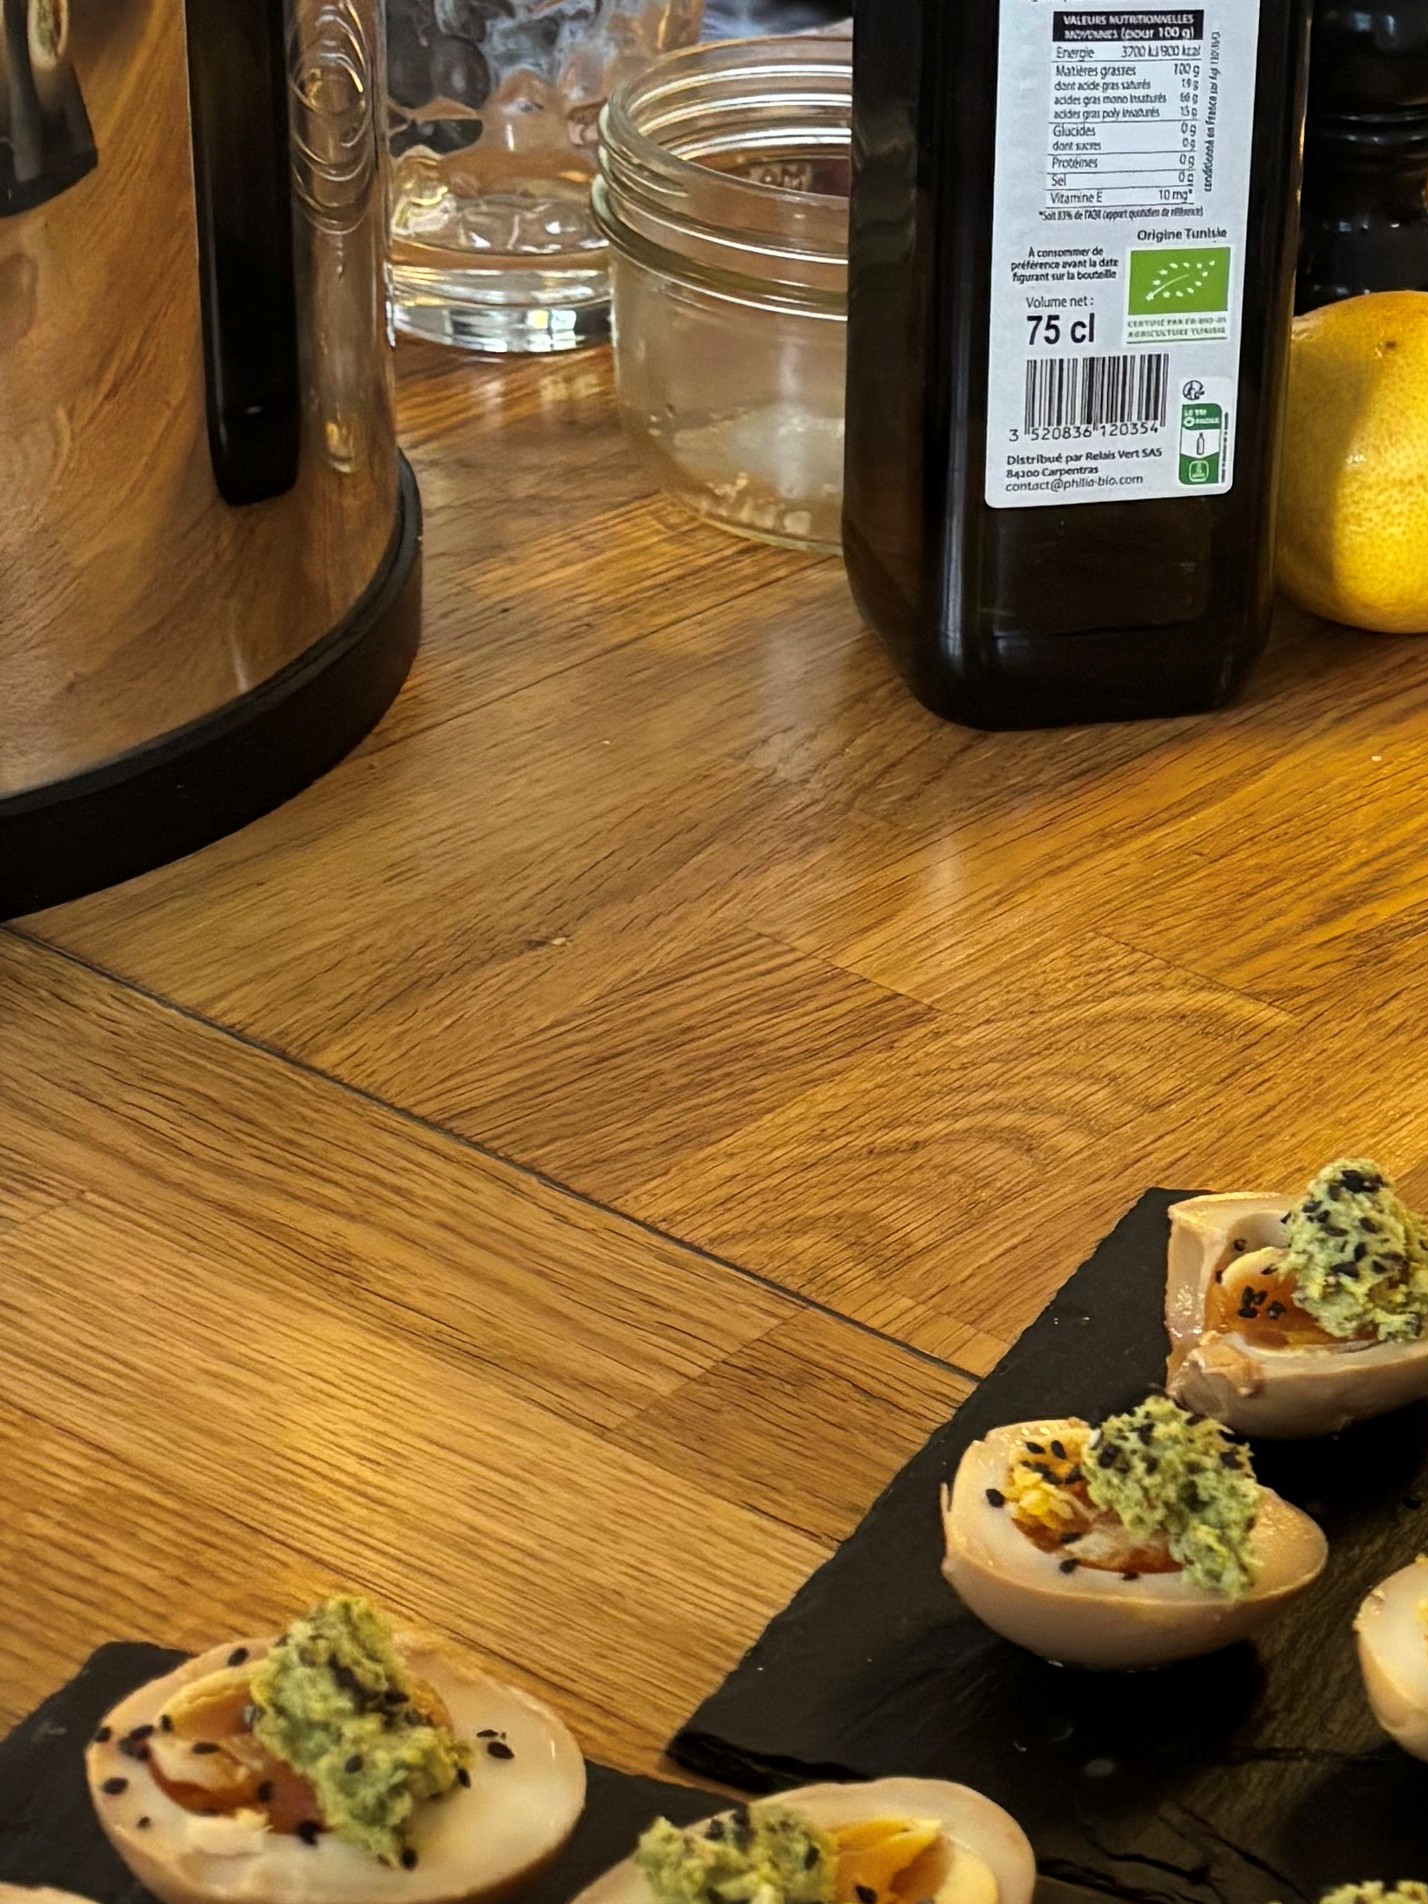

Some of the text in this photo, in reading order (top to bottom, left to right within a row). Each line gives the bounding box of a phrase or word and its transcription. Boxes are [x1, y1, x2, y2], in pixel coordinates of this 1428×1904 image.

[1063, 14, 1194, 25] VALEURS NUTRITIONNELLES
[1121, 27, 1154, 40] (pour
[1158, 27, 1179, 38] 100
[1182, 27, 1194, 40] g)
[1055, 65, 1098, 76] Matières
[1100, 65, 1136, 80] grasses
[1054, 81, 1076, 91] dont
[1102, 81, 1119, 92] gras
[1122, 79, 1151, 90] saturés
[1054, 94, 1081, 105] acides
[1083, 95, 1101, 107] gras
[1102, 96, 1128, 104] mono
[1102, 109, 1119, 120] poly
[1053, 122, 1197, 137] Glucides 0 g
[1052, 141, 1073, 151] dont
[1182, 137, 1189, 148] 0
[1052, 153, 1195, 169] Protéines 0 g
[1051, 174, 1067, 186] Sel
[1178, 171, 1186, 183] 0
[1051, 192, 1095, 204] Vitamine
[1096, 192, 1103, 203] E
[1159, 189, 1170, 201] 10
[1074, 210, 1083, 220] de
[1137, 227, 1227, 243] Origine Tunisie
[1037, 249, 1090, 257] consommer
[1091, 247, 1104, 256] de
[1011, 257, 1119, 272] préférence avant la date
[1012, 269, 1116, 285] figurant sur la bouteille
[1026, 296, 1067, 308] Volume
[1070, 296, 1088, 307] net
[1026, 313, 1095, 345] 75 cl
[1009, 423, 1158, 442] 3 520836 120354
[1007, 448, 1162, 465] Distribué par Relais Vert SAS
[1041, 465, 1098, 480] Carpentras
[1005, 475, 1143, 492] contact@philia-bio.com
